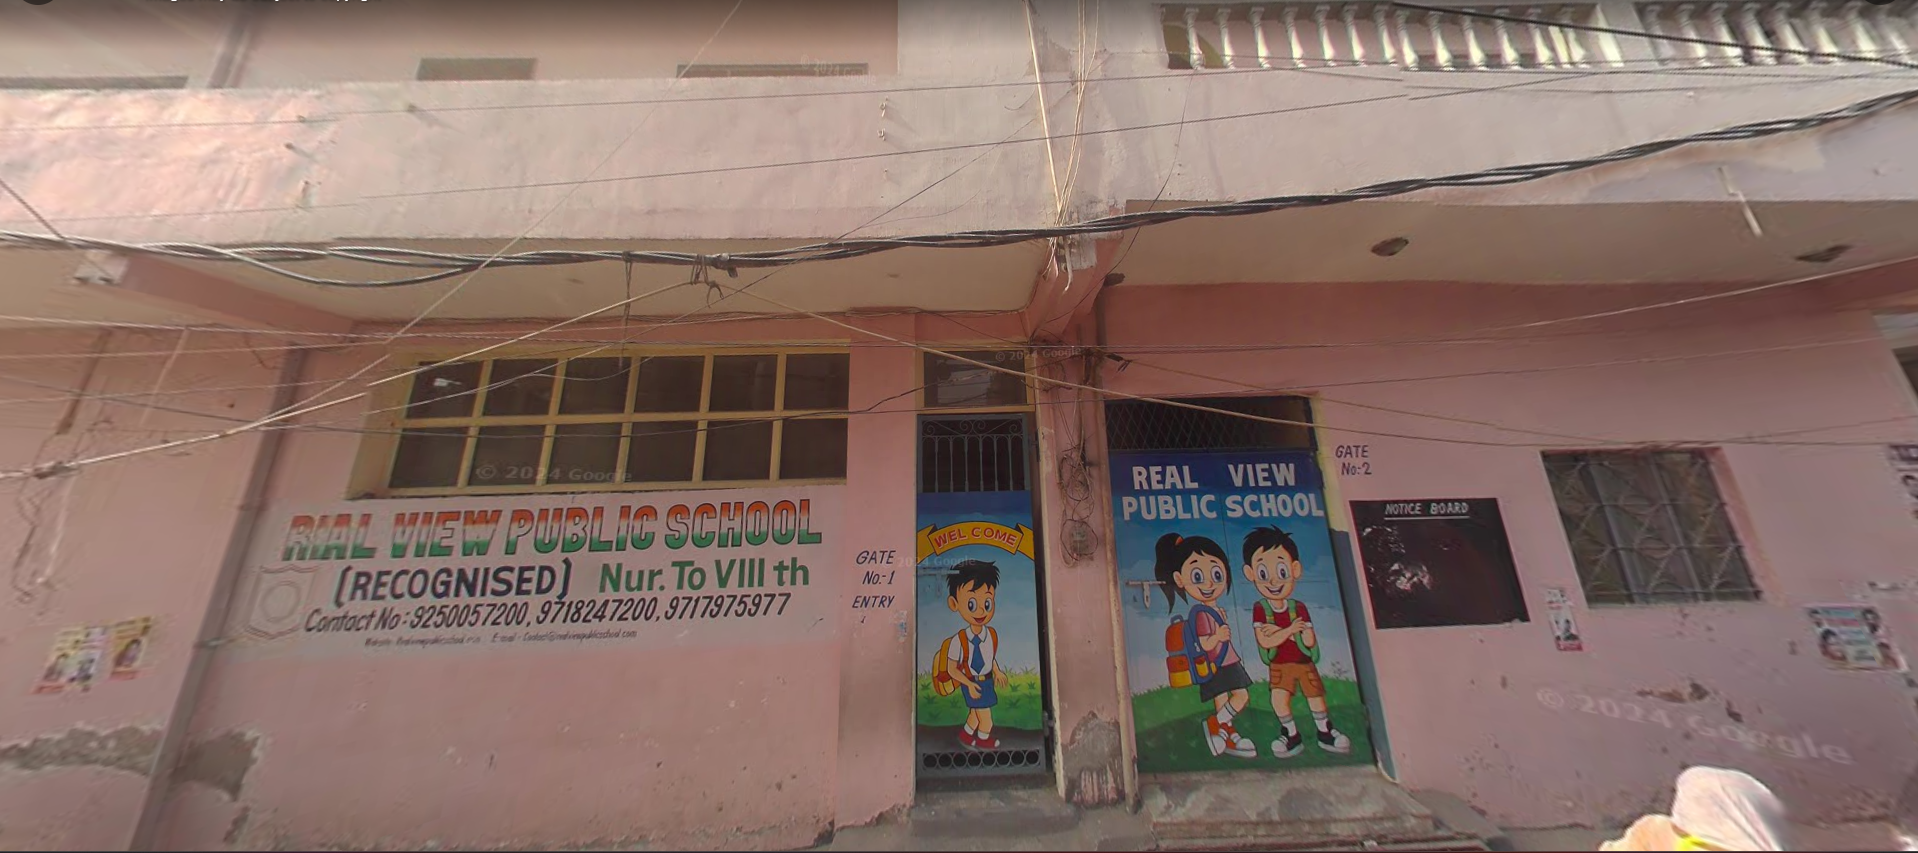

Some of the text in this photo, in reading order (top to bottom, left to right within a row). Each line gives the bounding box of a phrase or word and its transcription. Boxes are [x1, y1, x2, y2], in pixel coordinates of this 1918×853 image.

[1335, 445, 1369, 459] GATE
[1132, 463, 1296, 490] REAL VIEW
[1122, 492, 1324, 520] PUBLIC SCHOOL
[1385, 502, 1470, 515] NOTICE BOARD
[390, 509, 503, 559] VIEW
[504, 505, 658, 555] PUBLIC
[664, 499, 822, 550] SCHOOL
[856, 550, 896, 565] GATE
[334, 557, 809, 608] (RECOGNISED) Nur. To VIII th
[304, 608, 376, 633] Contact
[664, 593, 791, 619] 9717975977
[852, 595, 895, 609] ENTRY
